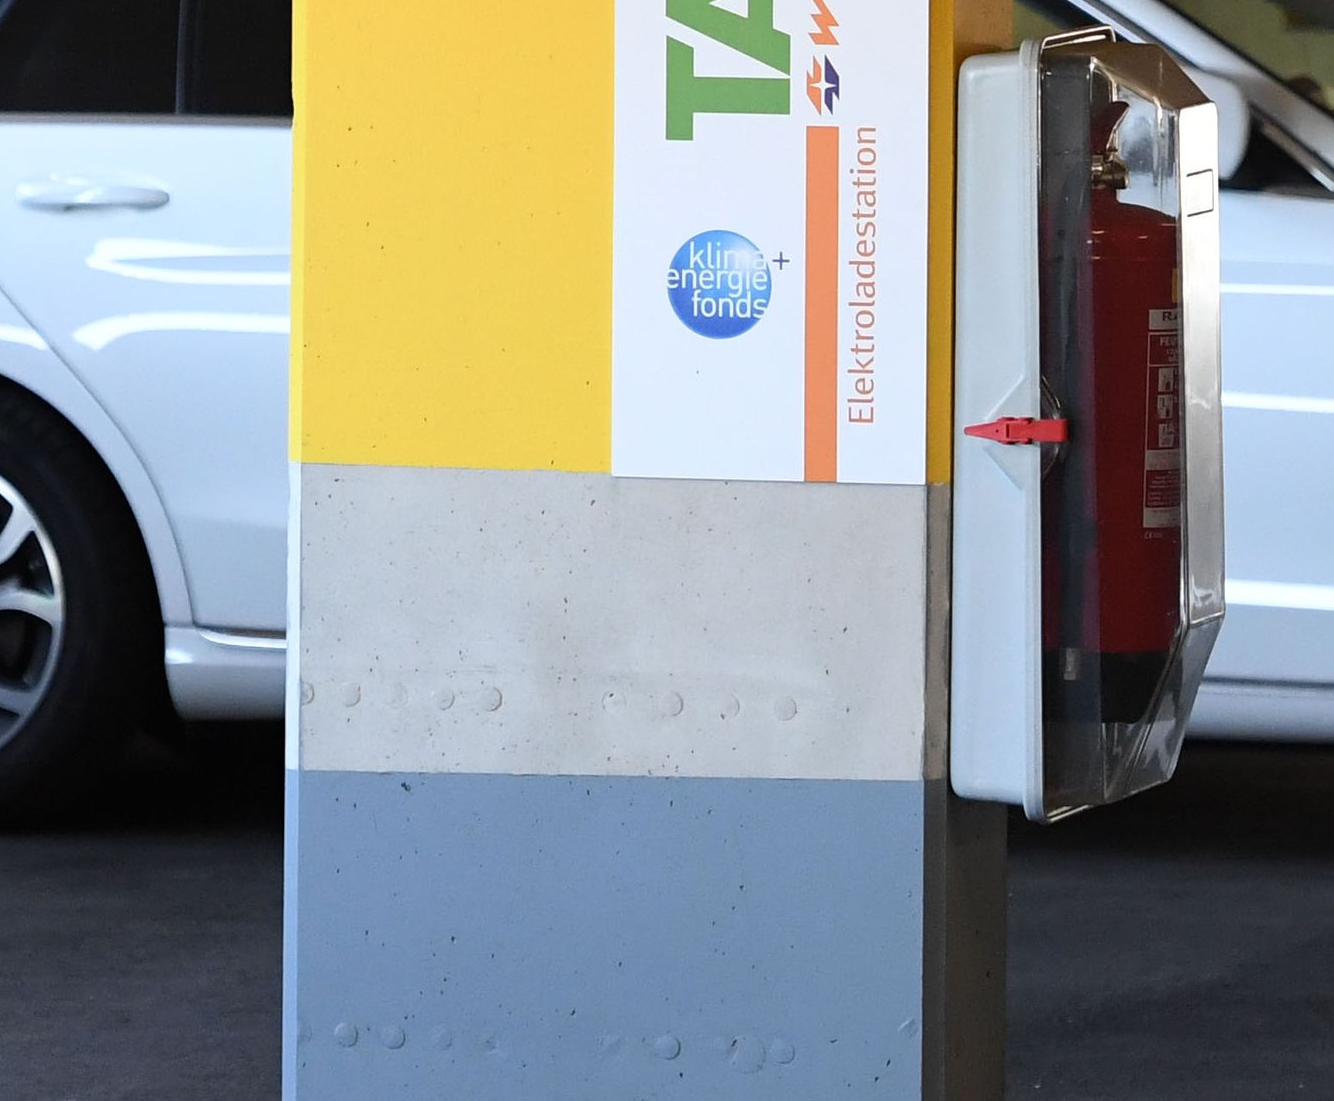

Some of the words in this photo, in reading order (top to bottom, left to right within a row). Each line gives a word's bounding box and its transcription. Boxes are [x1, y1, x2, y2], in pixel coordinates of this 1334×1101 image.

[667, 267, 768, 298] energie
[848, 126, 877, 424] Elektroladestation
[692, 289, 767, 319] fonds
